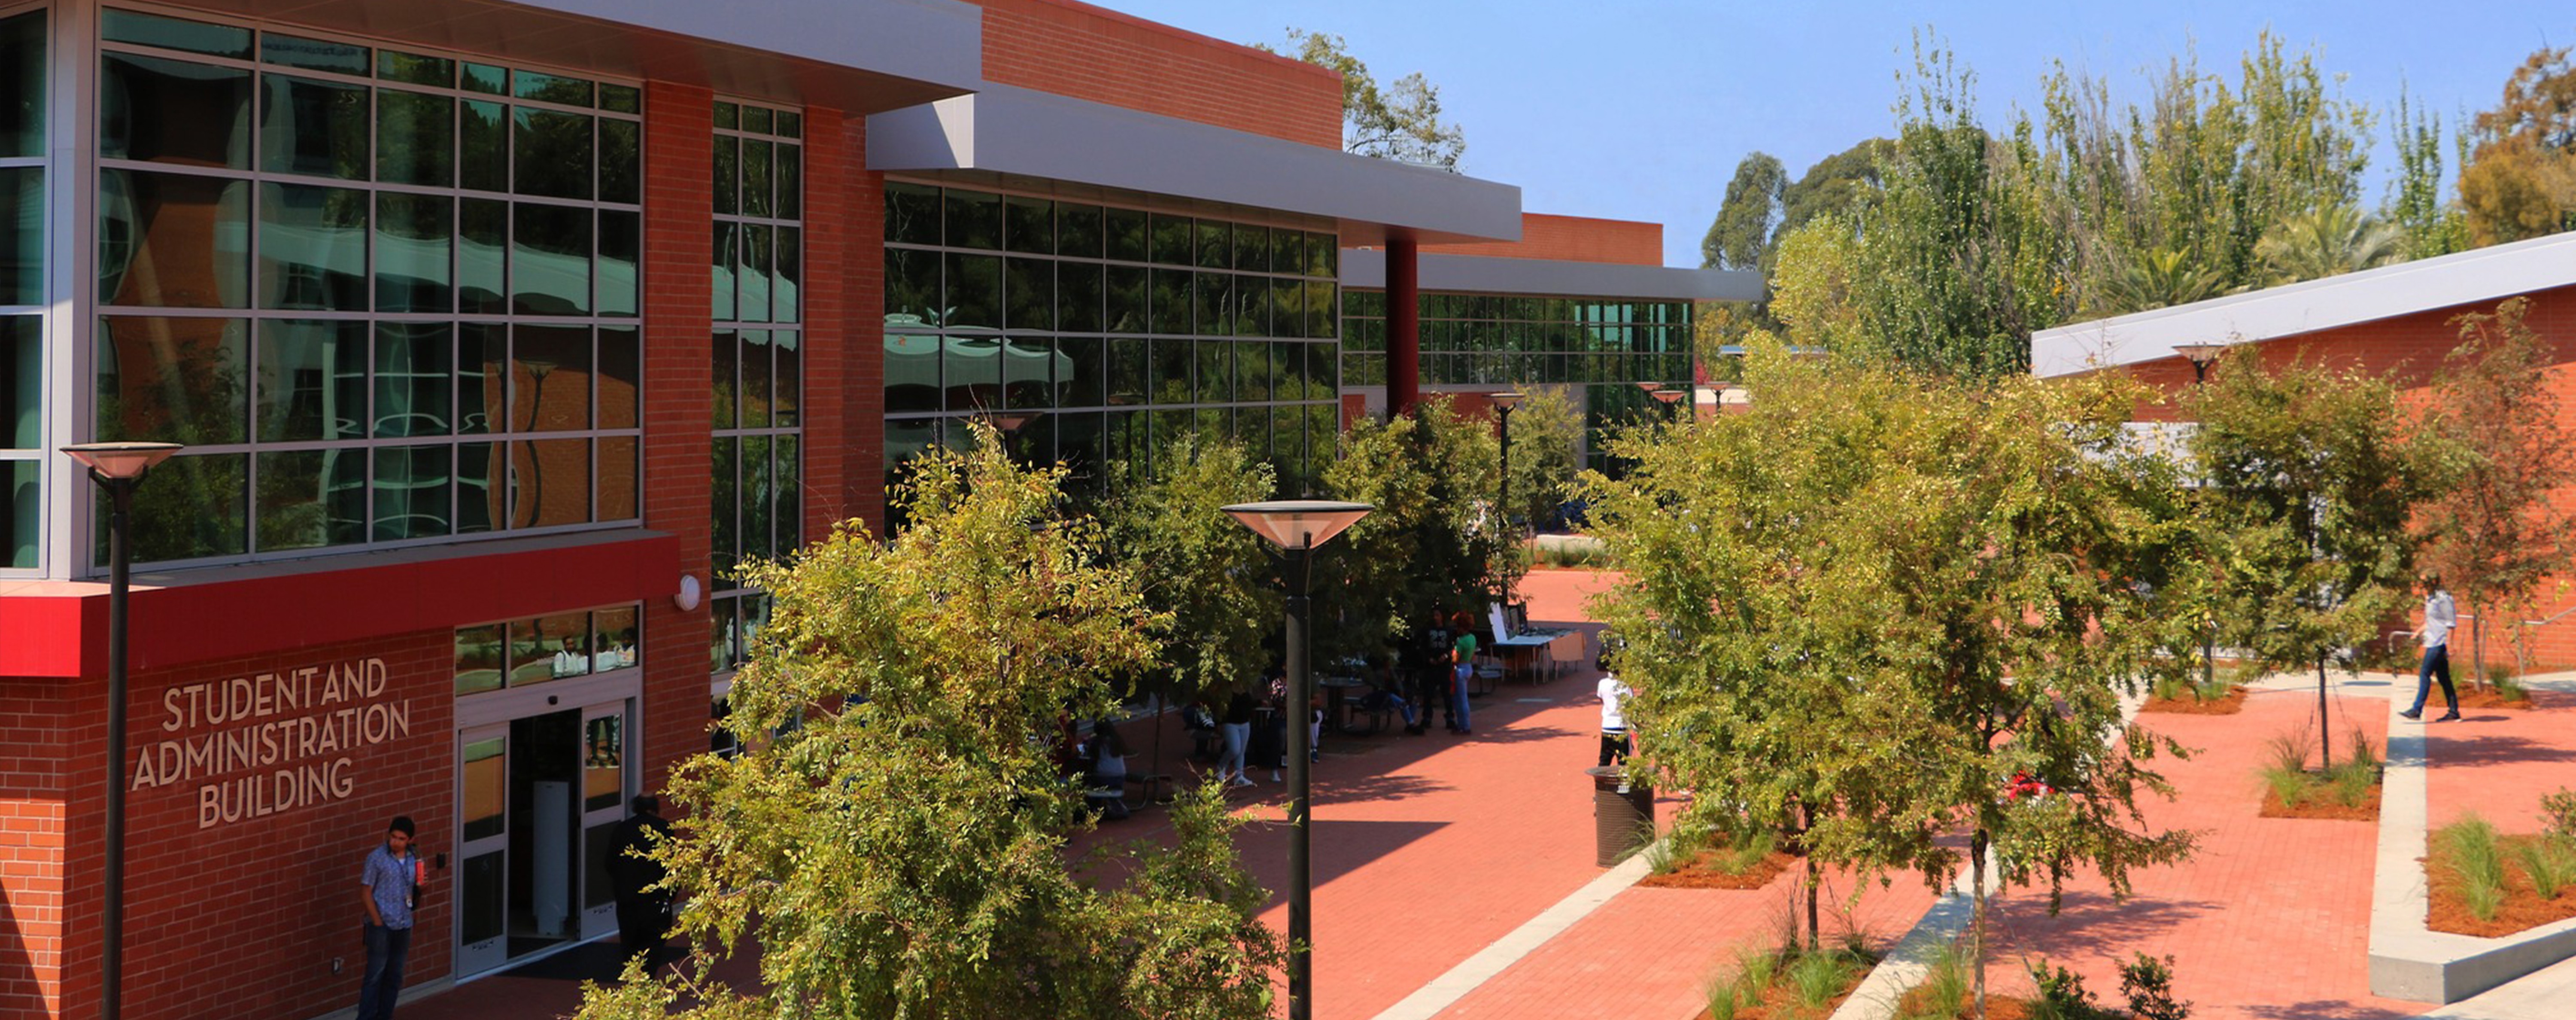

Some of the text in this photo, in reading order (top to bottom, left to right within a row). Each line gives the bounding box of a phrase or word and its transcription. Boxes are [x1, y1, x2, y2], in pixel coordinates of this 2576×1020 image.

[162, 658, 386, 731] STUDENT AND
[131, 699, 409, 791] ADMINISTRATION
[199, 757, 353, 829] BUILDING
